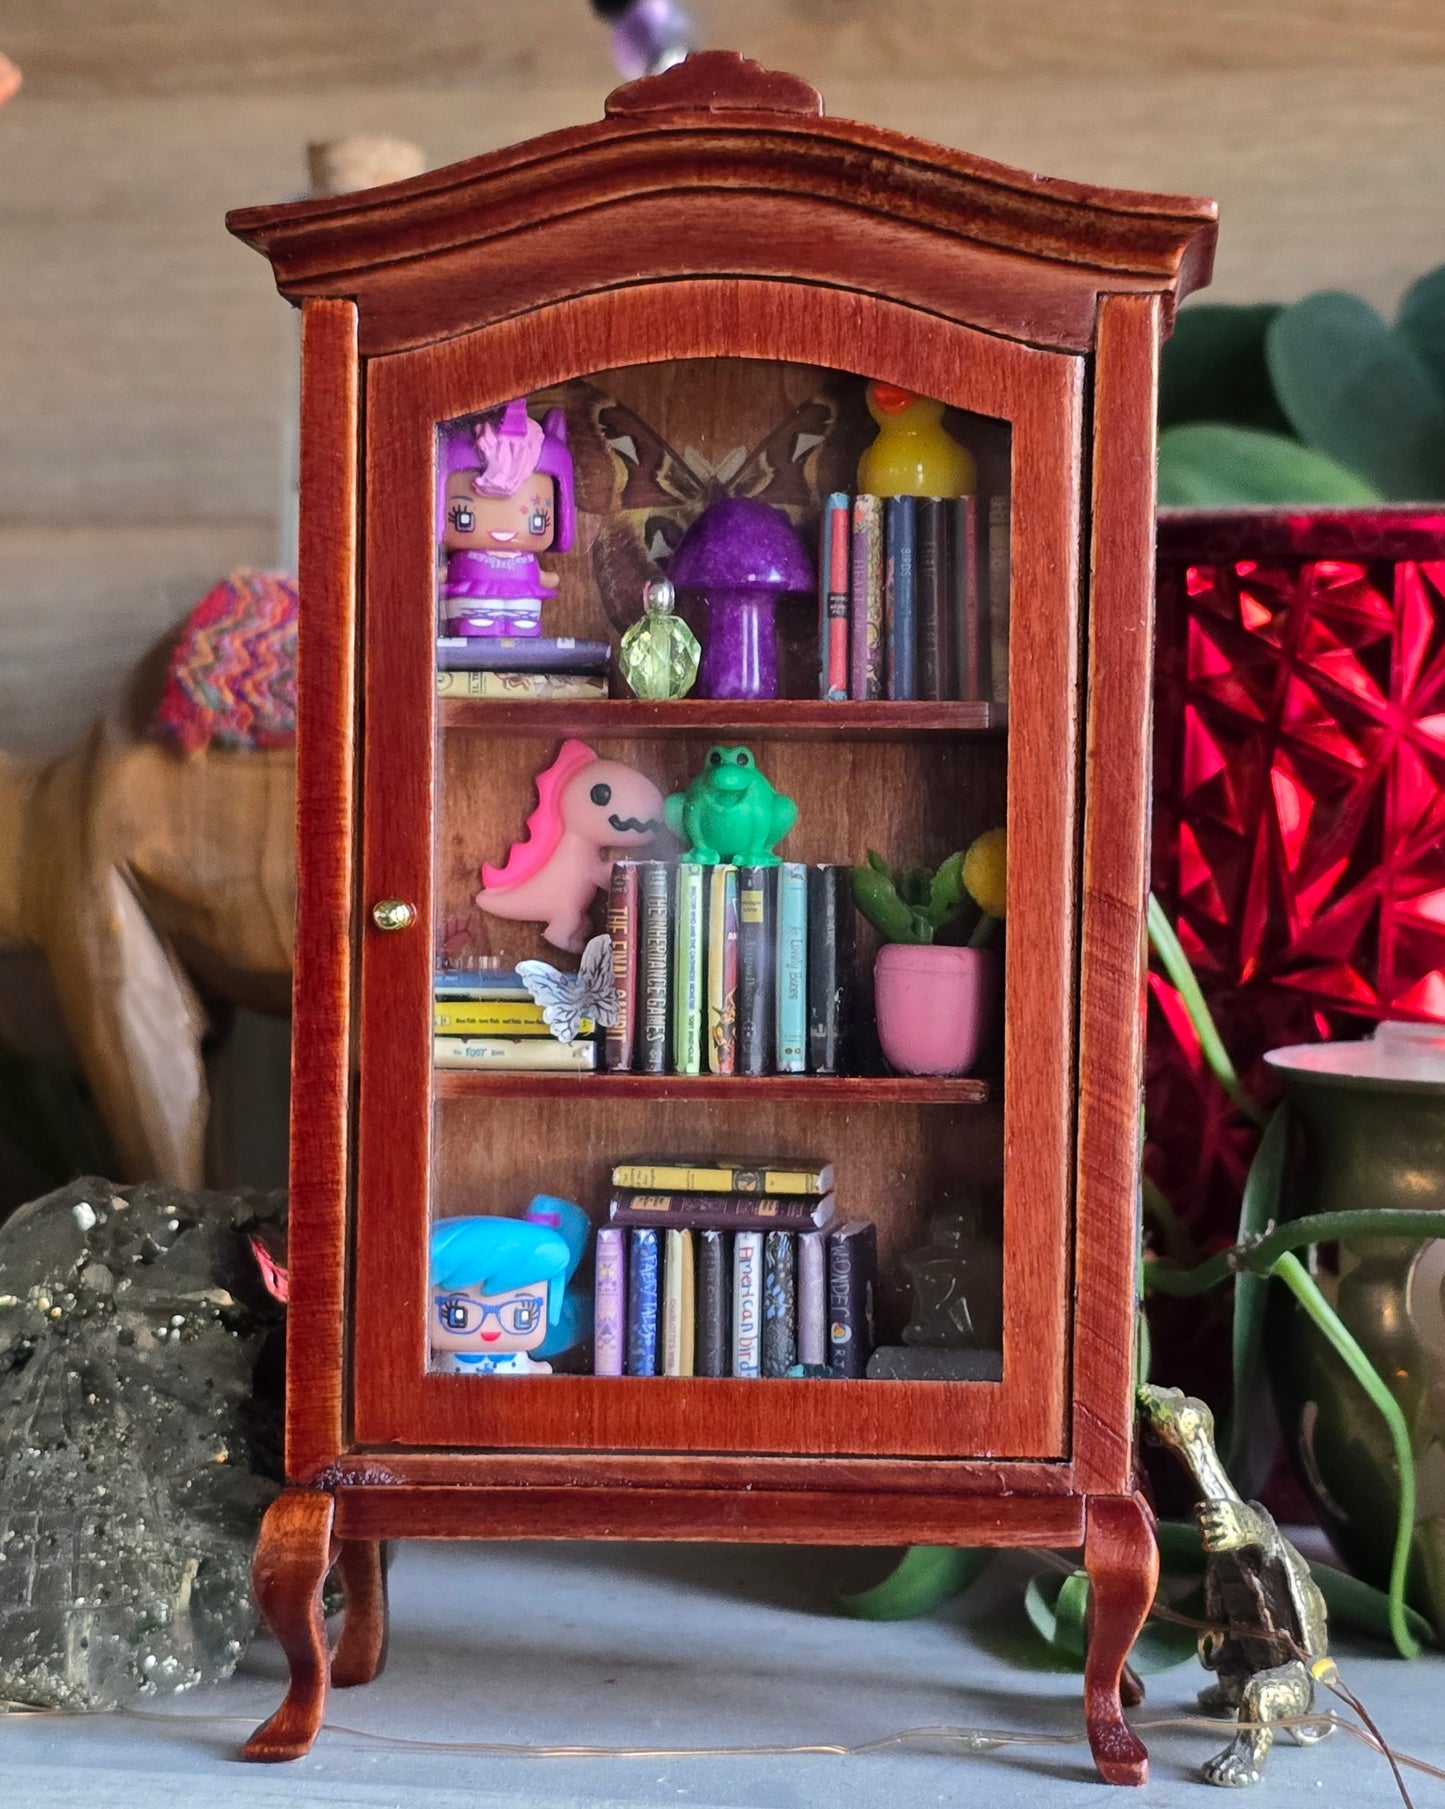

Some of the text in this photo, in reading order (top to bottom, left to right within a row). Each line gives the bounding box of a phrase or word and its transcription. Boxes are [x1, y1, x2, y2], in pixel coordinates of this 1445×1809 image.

[900, 547, 912, 577] BIRDS
[647, 892, 667, 915] THE
[608, 906, 628, 935] THE
[647, 916, 667, 993] INHERITANCE
[787, 939, 804, 970] Lovely
[787, 971, 803, 1000] Bones
[646, 997, 666, 1043] GAMES
[739, 1246, 755, 1333] American
[639, 1300, 657, 1339] TALES
